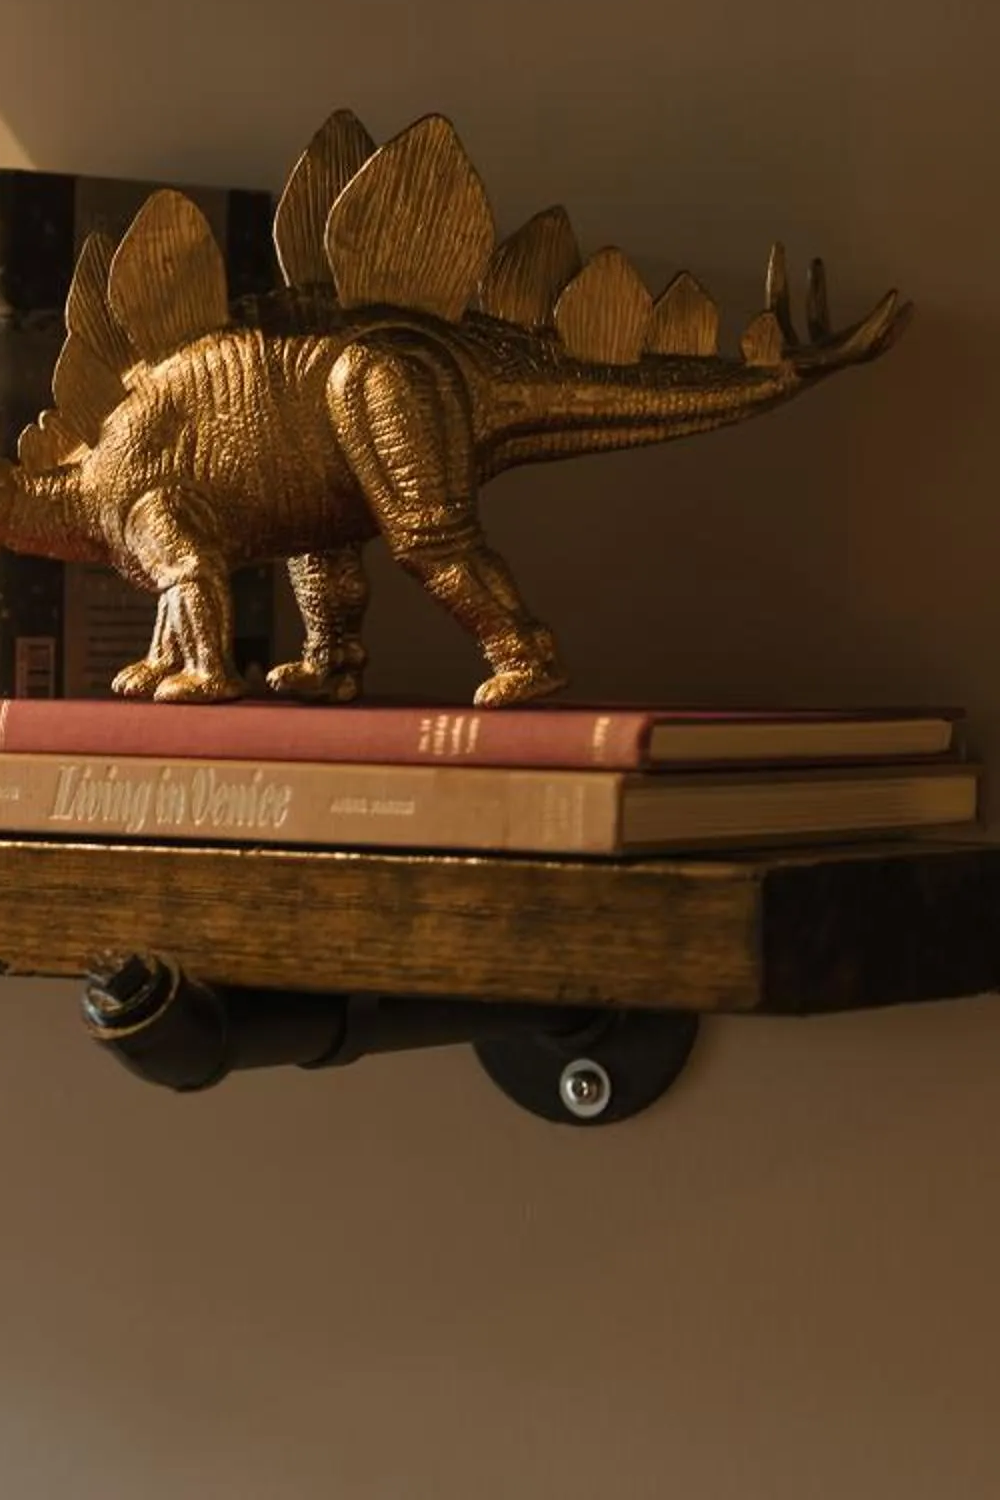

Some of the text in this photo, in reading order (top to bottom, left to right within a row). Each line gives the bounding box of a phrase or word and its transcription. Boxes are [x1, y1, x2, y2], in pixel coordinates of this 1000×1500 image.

[48, 765, 293, 833] Living in Venice
